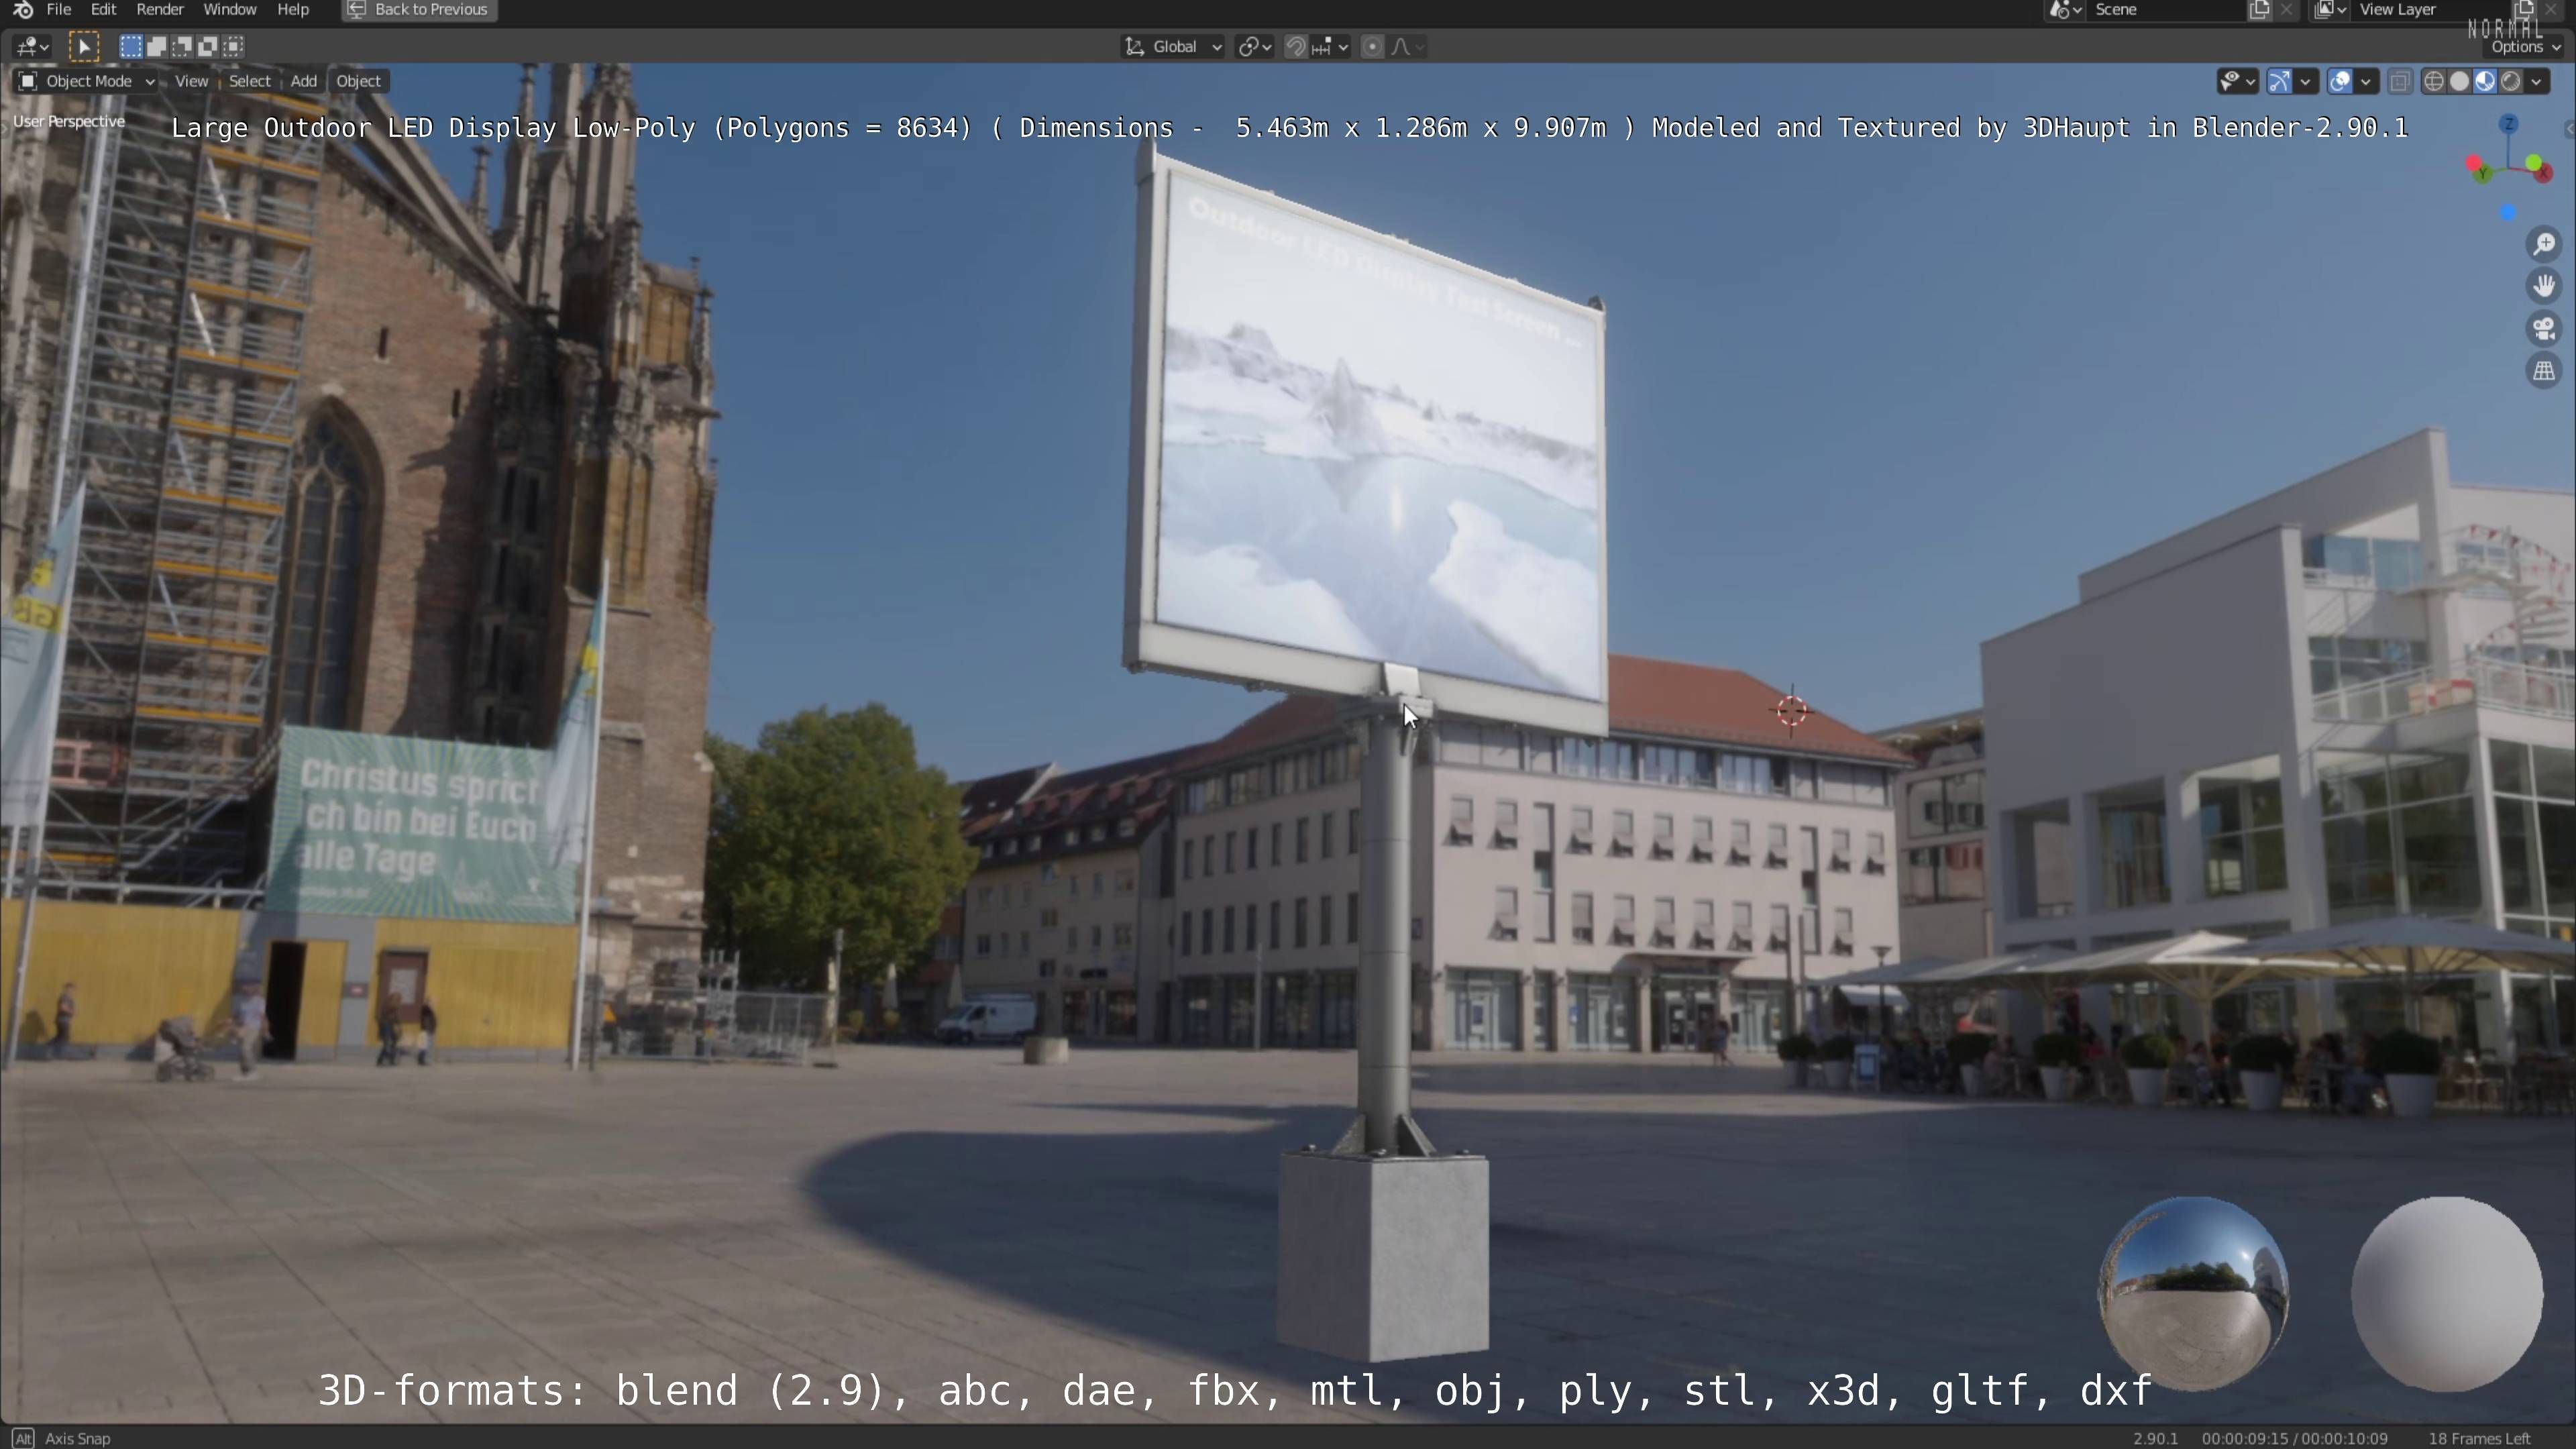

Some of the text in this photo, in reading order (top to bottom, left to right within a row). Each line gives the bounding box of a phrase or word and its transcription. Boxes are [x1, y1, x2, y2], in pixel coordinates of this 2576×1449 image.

[301, 757, 438, 798] Christus
[306, 799, 537, 843] ch bin bei Euch
[295, 840, 437, 884] alle Tage
